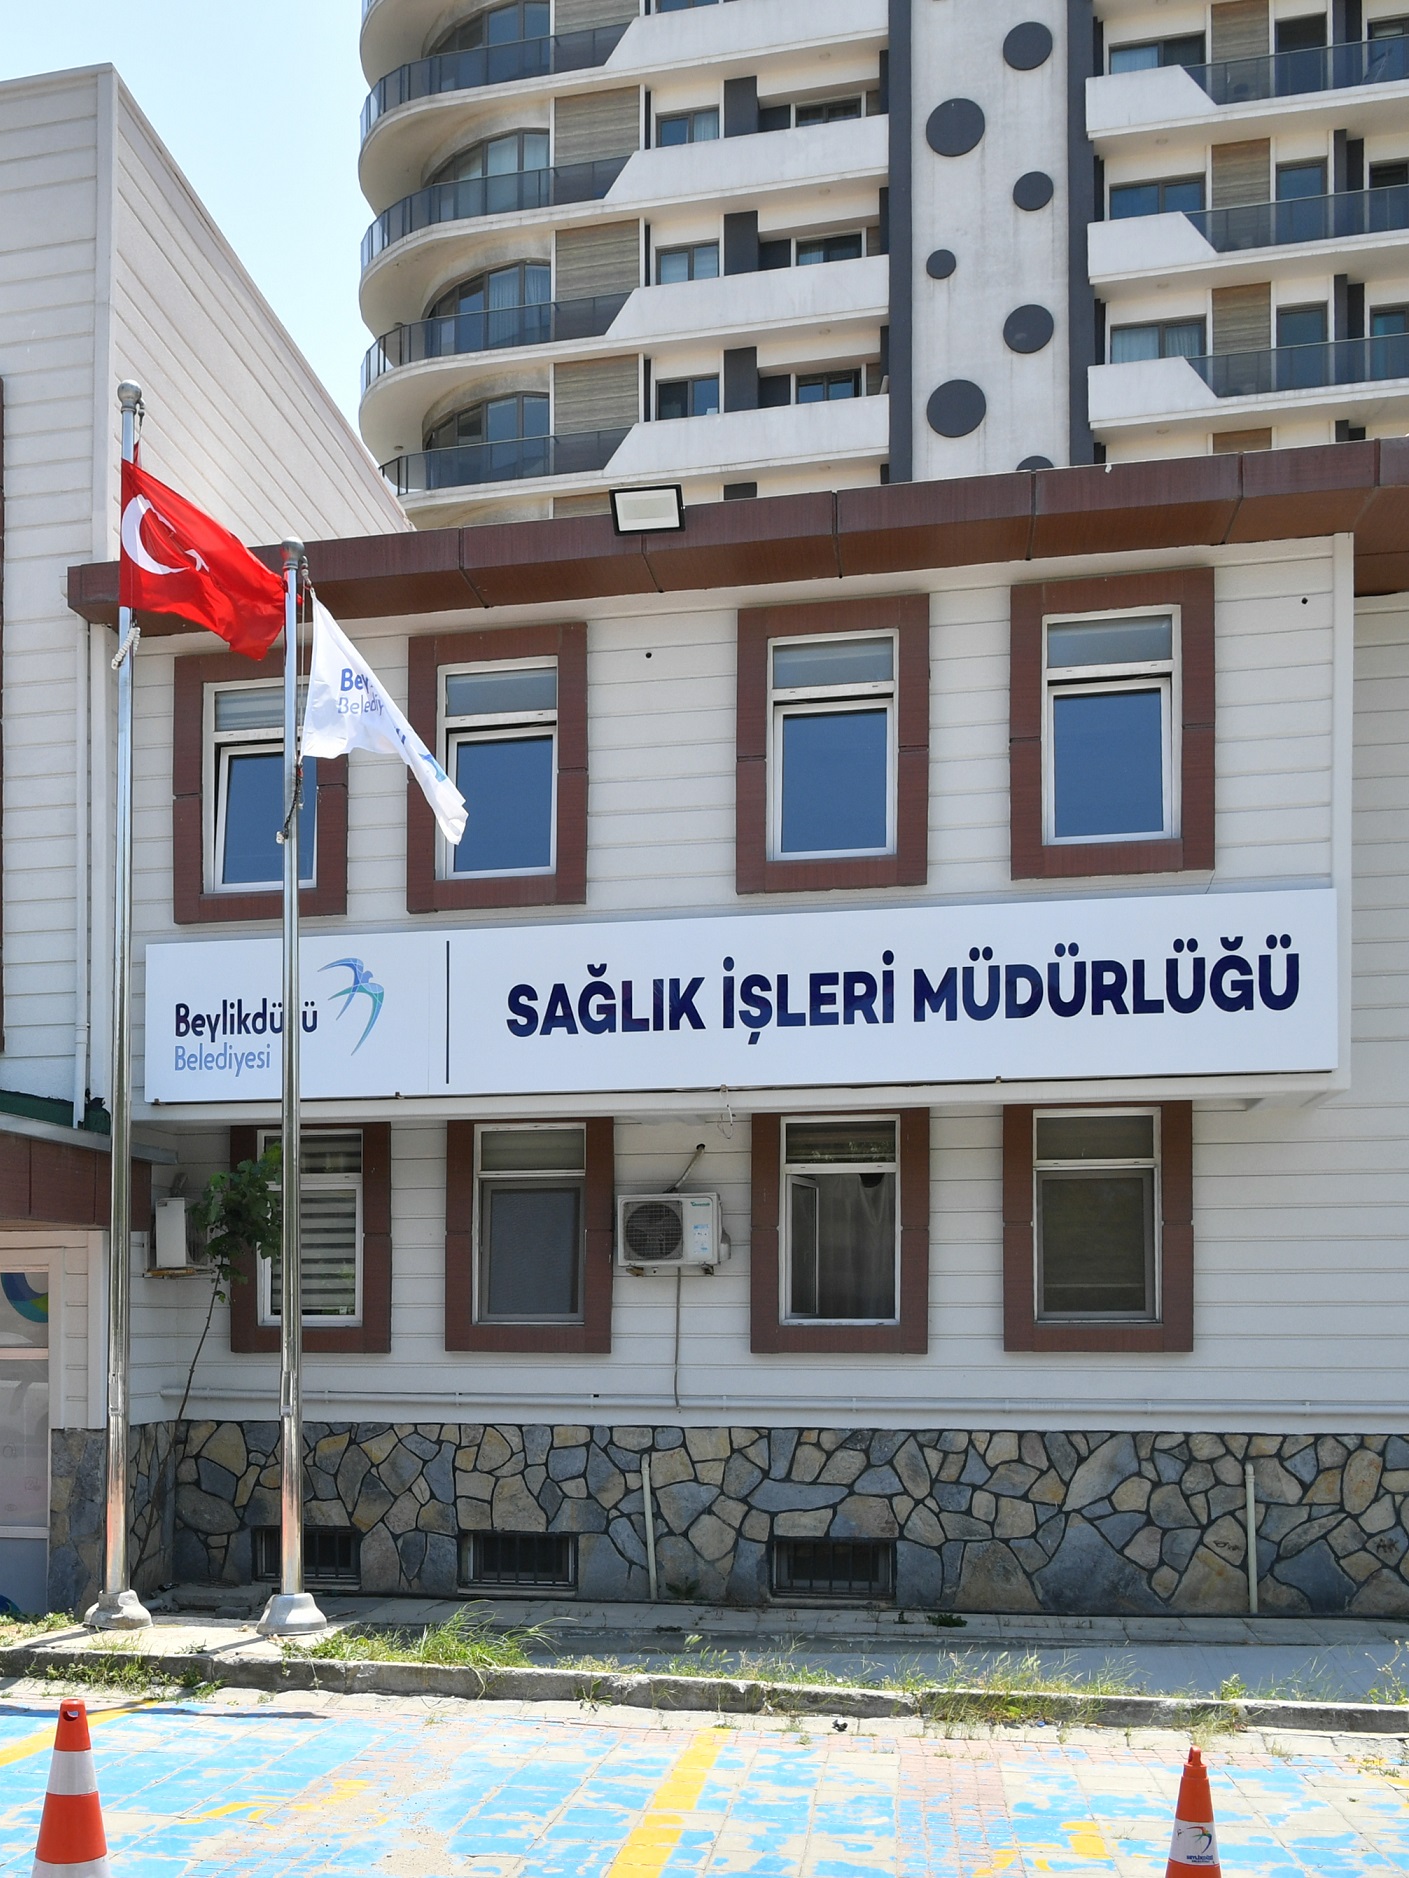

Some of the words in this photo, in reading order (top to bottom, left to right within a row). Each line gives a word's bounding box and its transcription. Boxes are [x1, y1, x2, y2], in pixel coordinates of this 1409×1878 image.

[338, 692, 384, 716] Belediy
[506, 963, 706, 1037] SAĞLIK
[722, 949, 894, 1045] İŞLERİ
[913, 934, 1300, 1022] MÜDÜRLÜĞÜ
[175, 998, 318, 1043] Beylikdüü
[175, 1042, 271, 1077] Belediyesi
